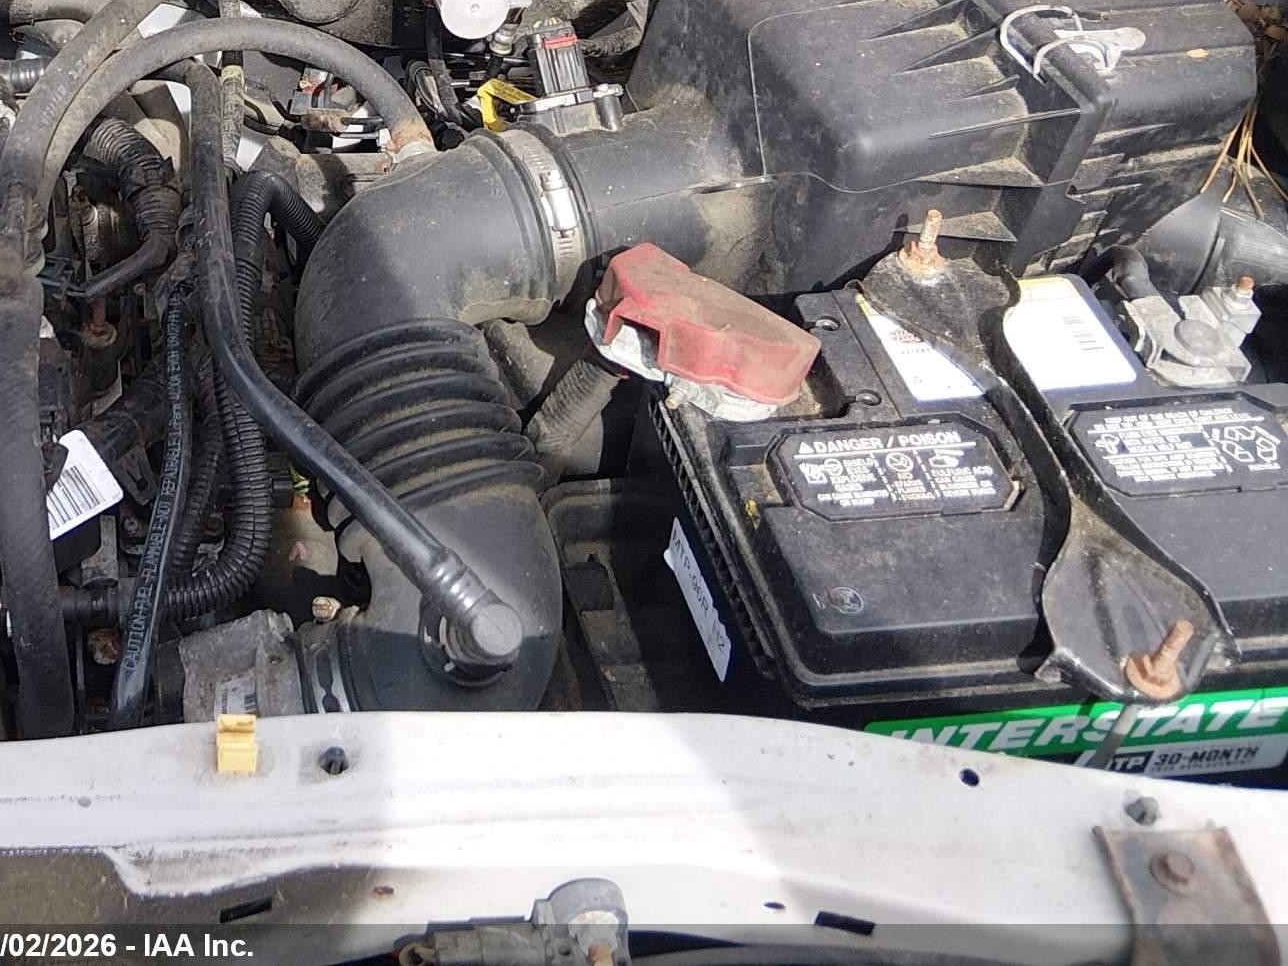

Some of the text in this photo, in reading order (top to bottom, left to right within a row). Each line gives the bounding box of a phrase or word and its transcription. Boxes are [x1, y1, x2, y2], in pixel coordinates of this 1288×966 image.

[813, 437, 883, 454] DANGER
[898, 431, 962, 447] POISON
[1155, 747, 1260, 767] 30-MONTH
